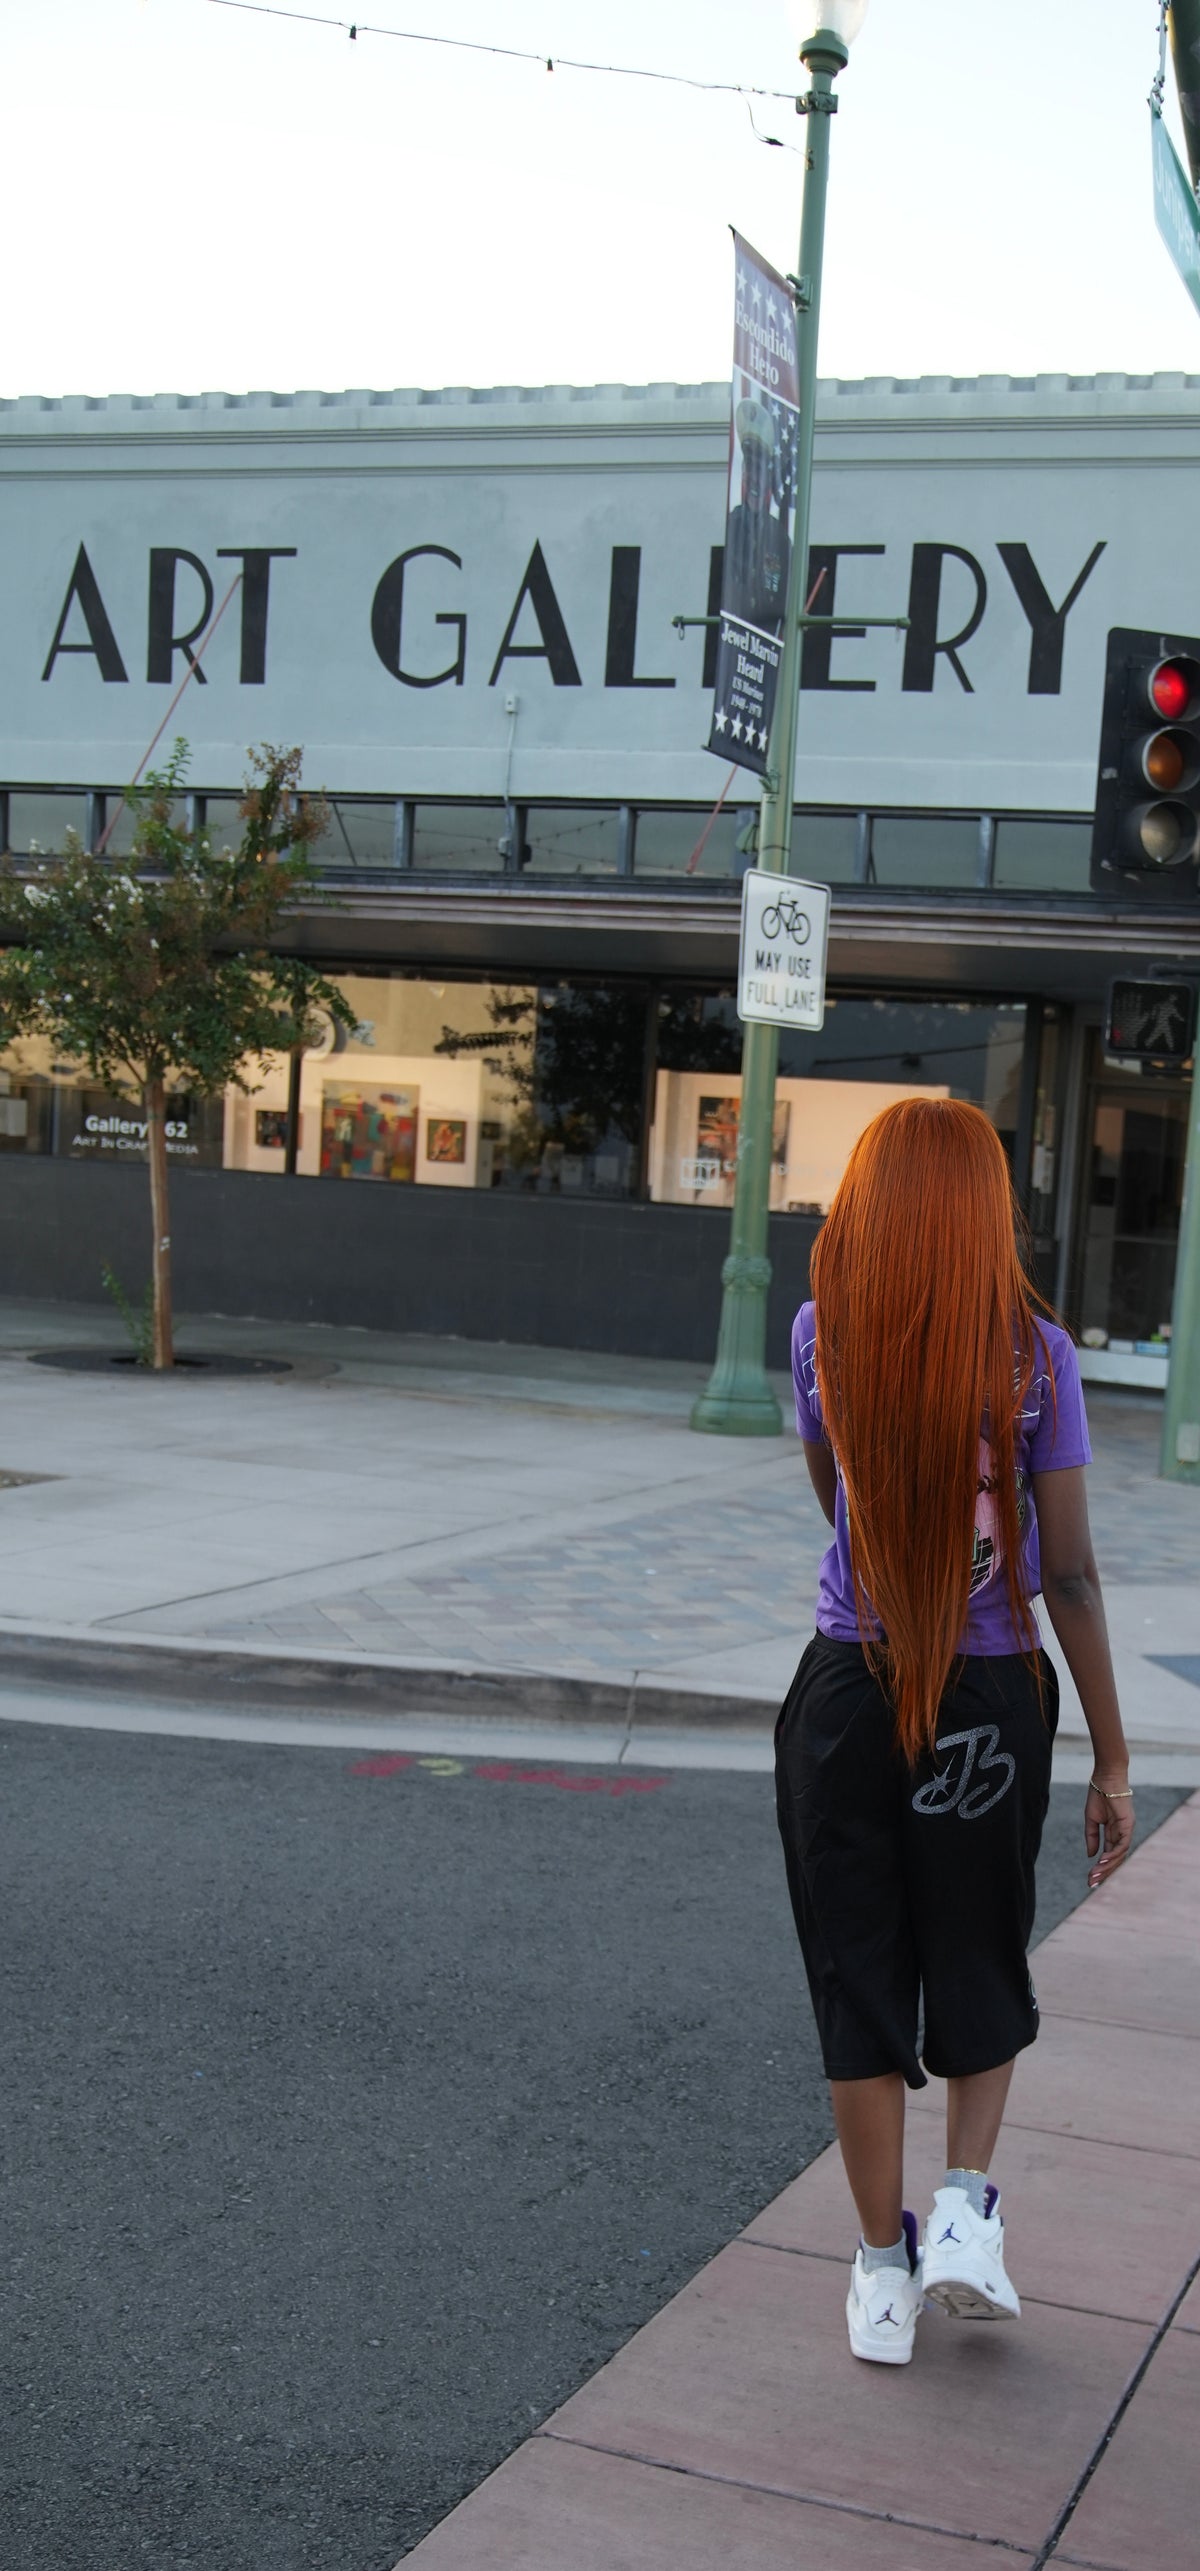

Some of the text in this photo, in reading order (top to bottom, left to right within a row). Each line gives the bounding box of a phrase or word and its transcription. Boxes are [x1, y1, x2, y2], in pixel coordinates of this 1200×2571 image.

[736, 301, 795, 366] Escondido
[750, 343, 779, 385] Hero
[41, 538, 1108, 695] ART GALERY
[722, 622, 778, 667] Jewel Marvin
[737, 654, 764, 683] Heard
[756, 950, 811, 979] MAY USE
[748, 982, 815, 1012] FULL LANE
[85, 1115, 149, 1138] Gallery
